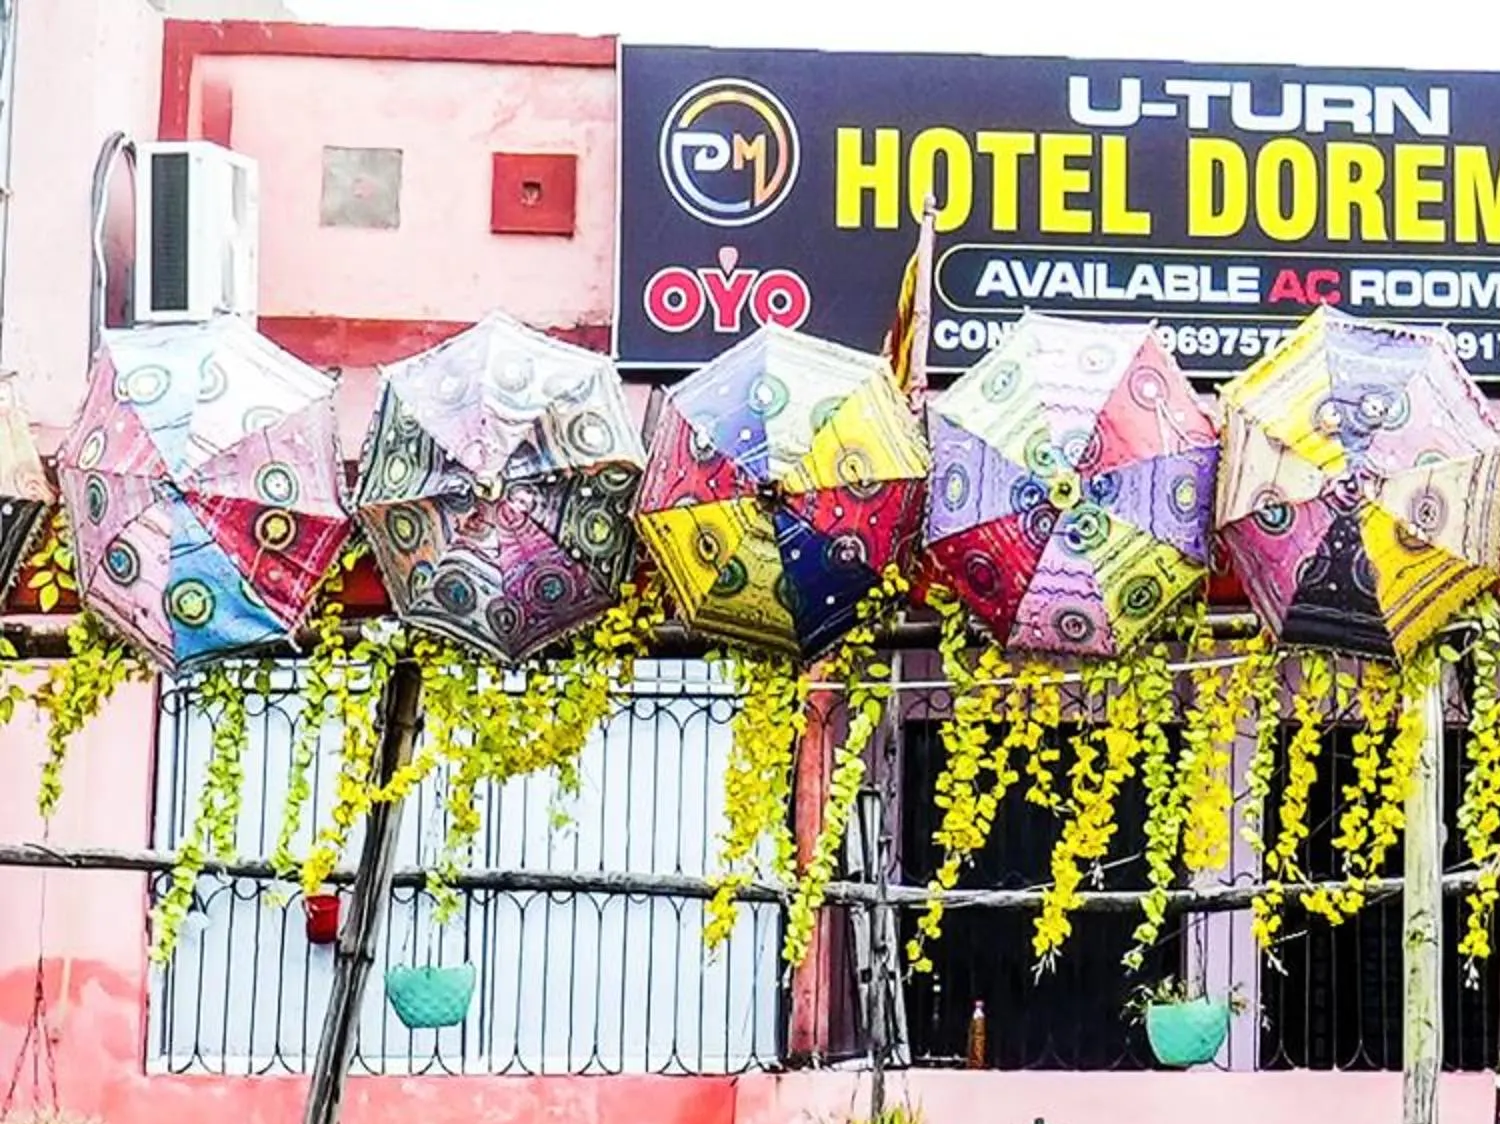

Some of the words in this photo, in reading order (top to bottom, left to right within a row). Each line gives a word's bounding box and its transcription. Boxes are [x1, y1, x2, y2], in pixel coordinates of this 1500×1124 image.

[1068, 75, 1451, 135] U-TURN
[835, 127, 1151, 236] HOTEL
[643, 265, 812, 333] OYO
[975, 259, 1261, 304] AVAILABLE
[1268, 269, 1342, 306] AC
